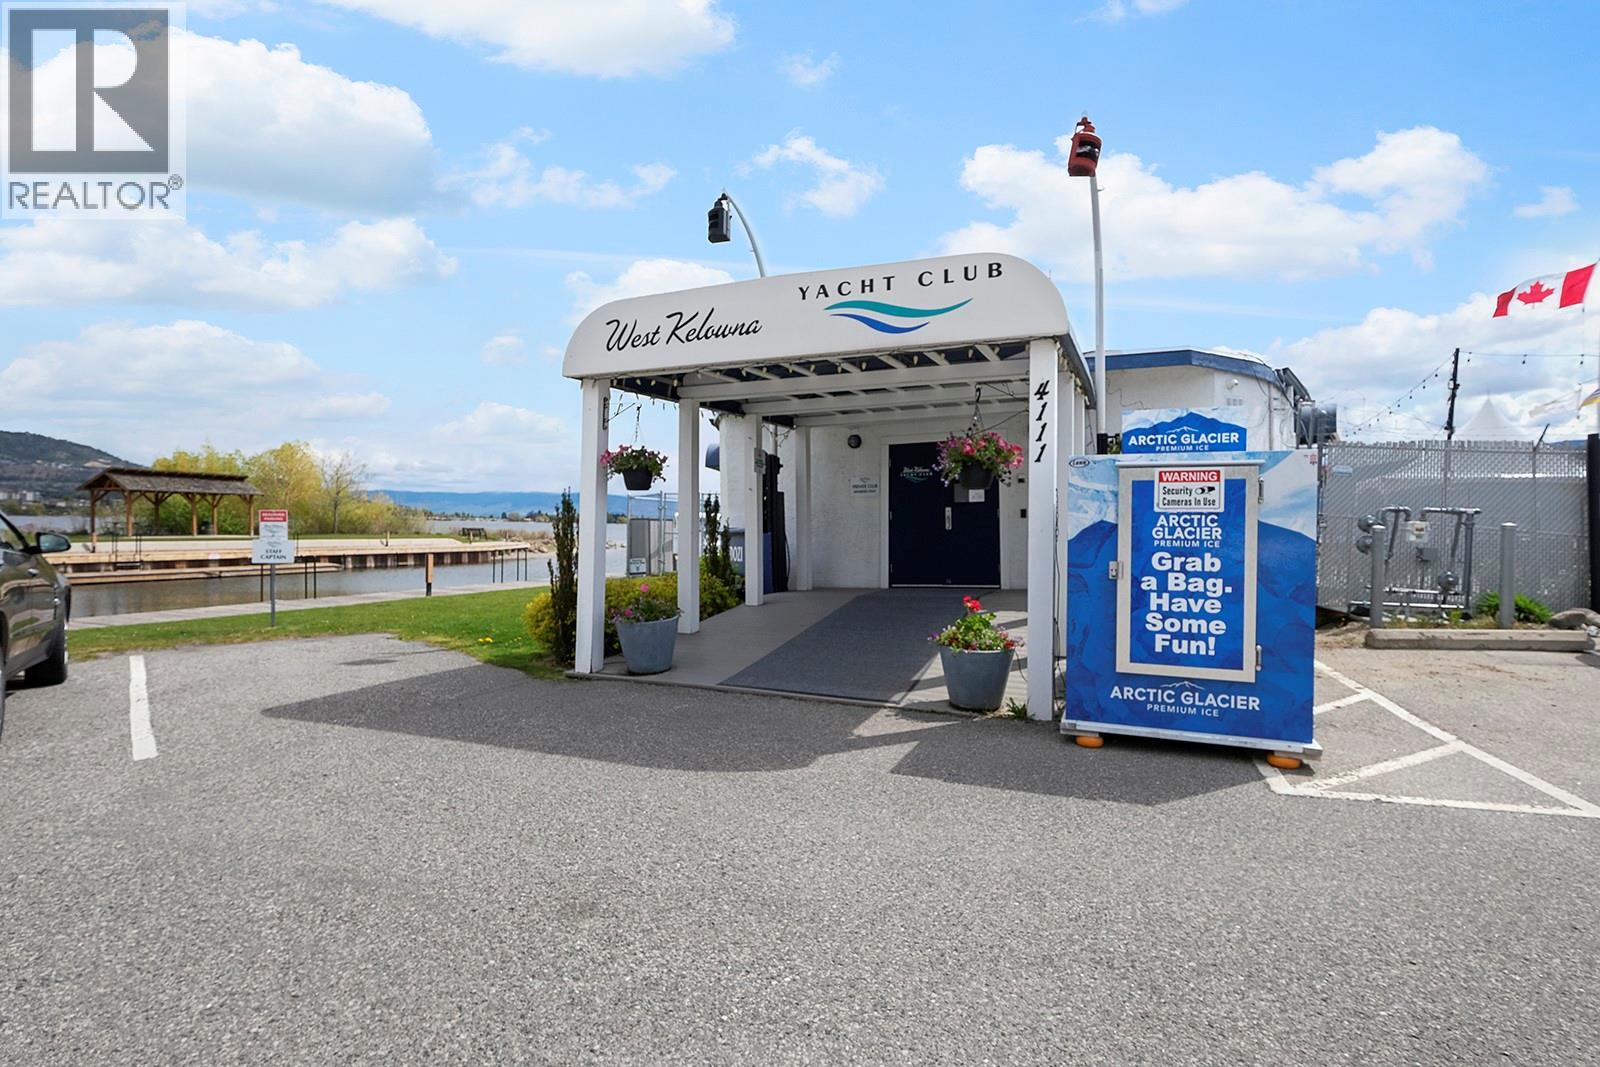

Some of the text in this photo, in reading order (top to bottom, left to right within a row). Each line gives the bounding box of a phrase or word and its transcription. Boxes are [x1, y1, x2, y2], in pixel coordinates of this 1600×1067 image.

[798, 262, 1003, 301] YACHT CLUB
[605, 307, 762, 352] West Kelowna
[1034, 380, 1050, 463] 4111
[1128, 432, 1240, 446] ARCTIC GLACIER
[1161, 471, 1218, 482] WARNING
[1162, 485, 1193, 497] Security
[1162, 497, 1216, 507] Cameras In Use
[1156, 514, 1218, 528] ARCTIC
[1152, 527, 1222, 540] GLACIER
[1154, 540, 1220, 548] PREMIUM ICE
[1151, 551, 1222, 573] Grab
[1141, 573, 1233, 597] a Bag.
[1150, 592, 1222, 614] Have
[1145, 612, 1227, 635] Some
[1154, 634, 1216, 656] Fun!
[1110, 685, 1260, 711] ARCTIC GLACIER
[1147, 703, 1220, 717] PREMIUM ICE
